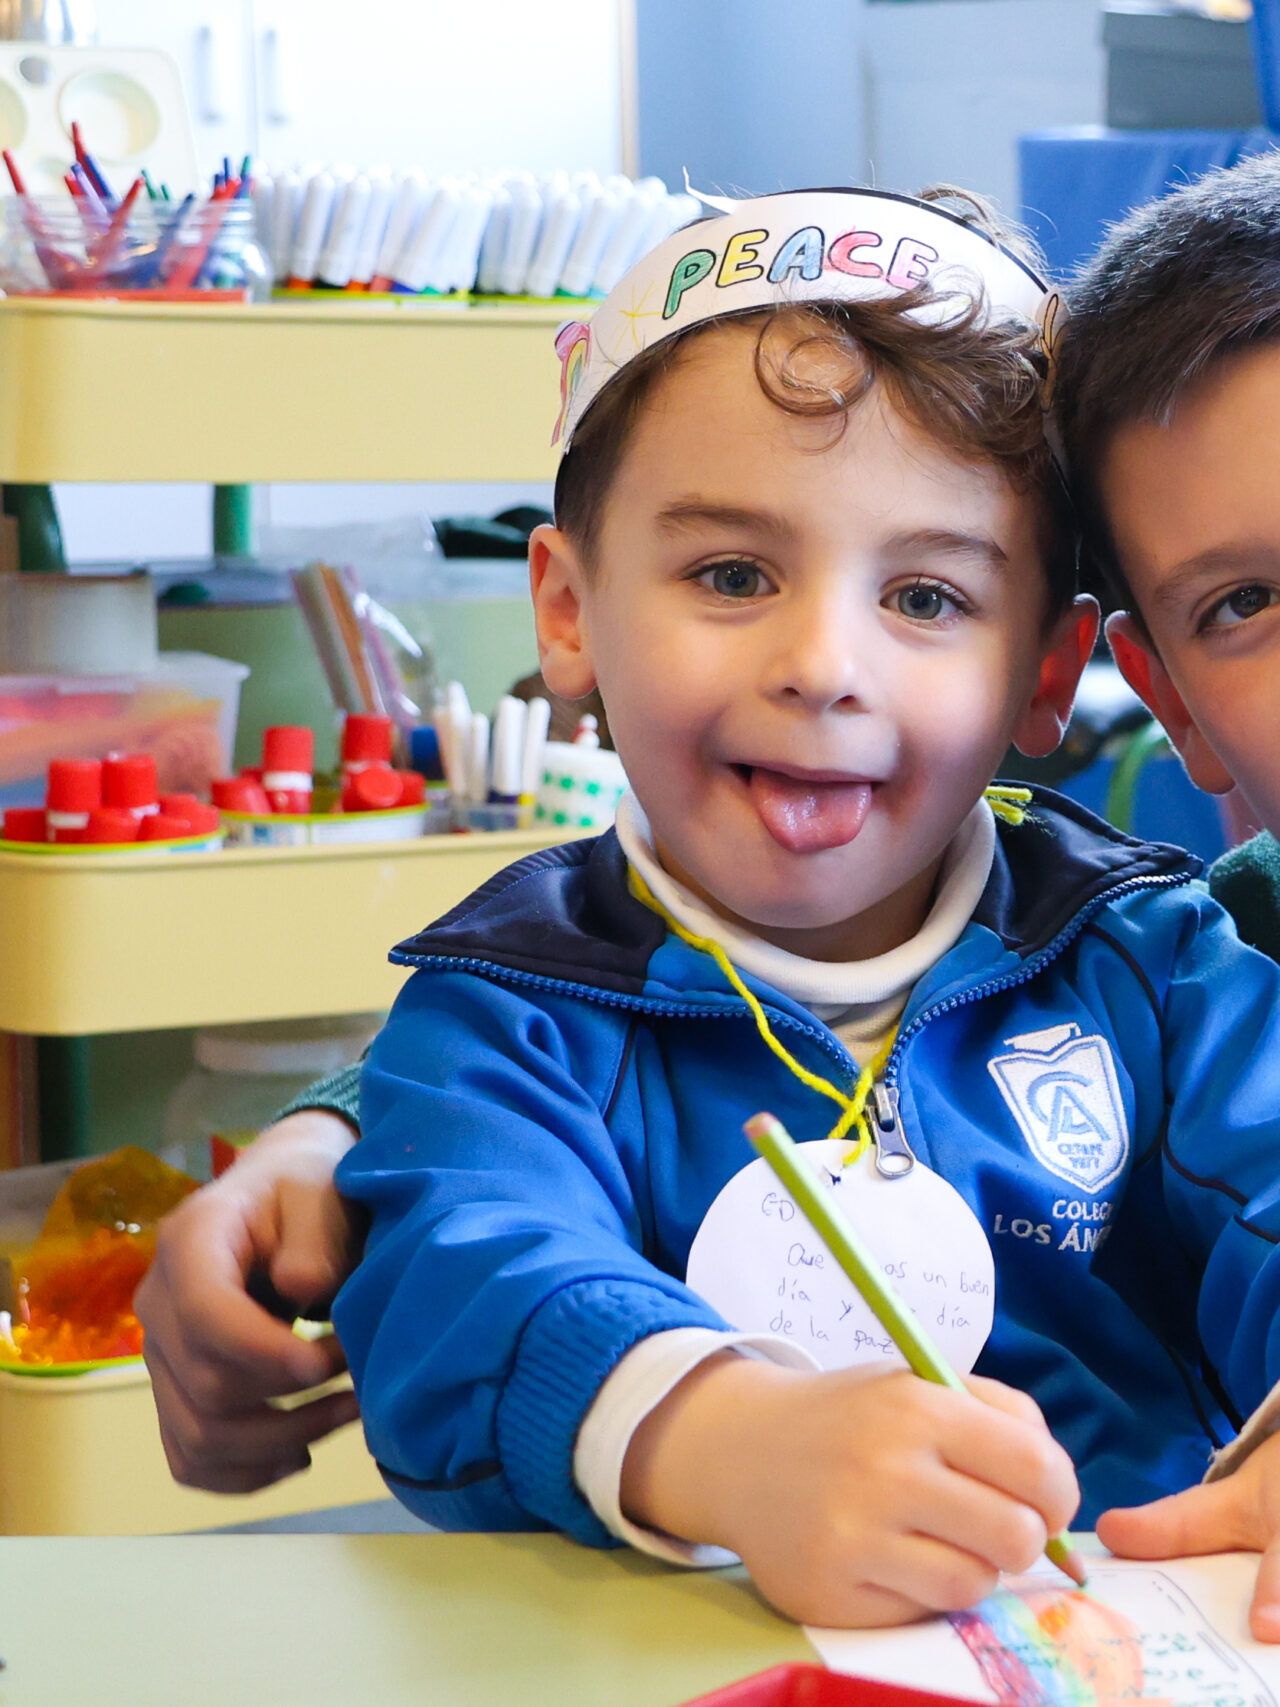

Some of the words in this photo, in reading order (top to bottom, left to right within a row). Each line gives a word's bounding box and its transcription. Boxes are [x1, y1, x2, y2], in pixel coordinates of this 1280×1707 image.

[662, 226, 939, 320] PEACE
[994, 1214, 1052, 1245] LOS
[923, 1272, 947, 1288] un
[960, 1271, 990, 1297] buen
[778, 1277, 812, 1302] día
[936, 1304, 970, 1327] día
[769, 1309, 793, 1335] de
[810, 1315, 830, 1342] la
